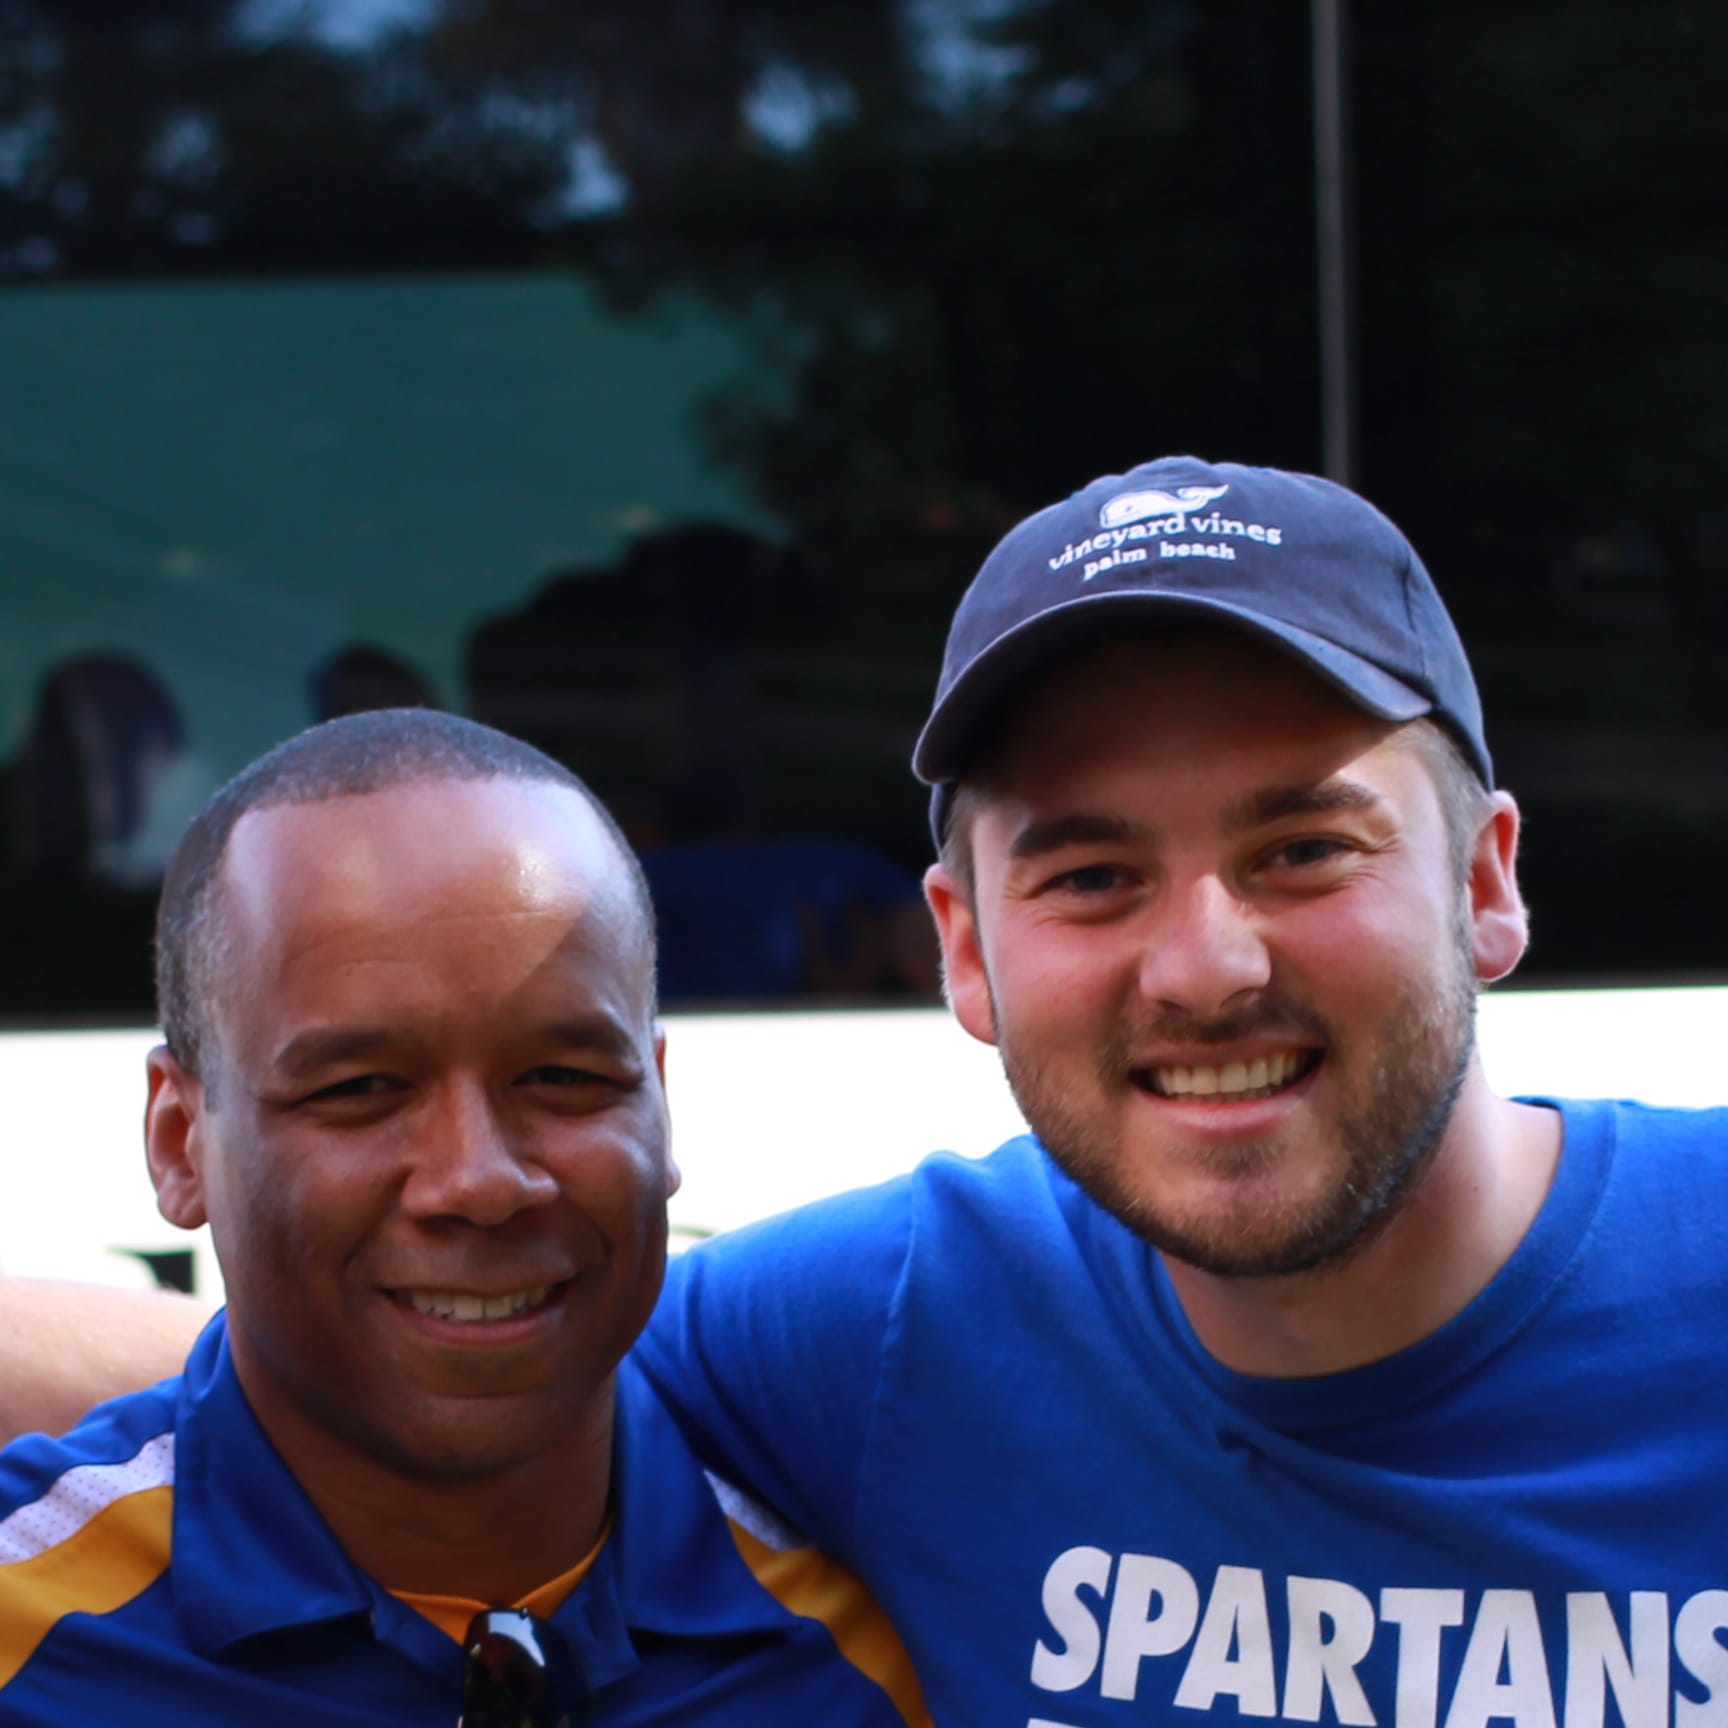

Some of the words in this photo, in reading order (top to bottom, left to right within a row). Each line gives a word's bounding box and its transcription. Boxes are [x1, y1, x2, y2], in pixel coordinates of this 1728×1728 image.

[1048, 512, 1186, 571] vineyard
[1191, 511, 1282, 546] vines
[1083, 547, 1147, 582] palm
[1159, 541, 1236, 561] beach
